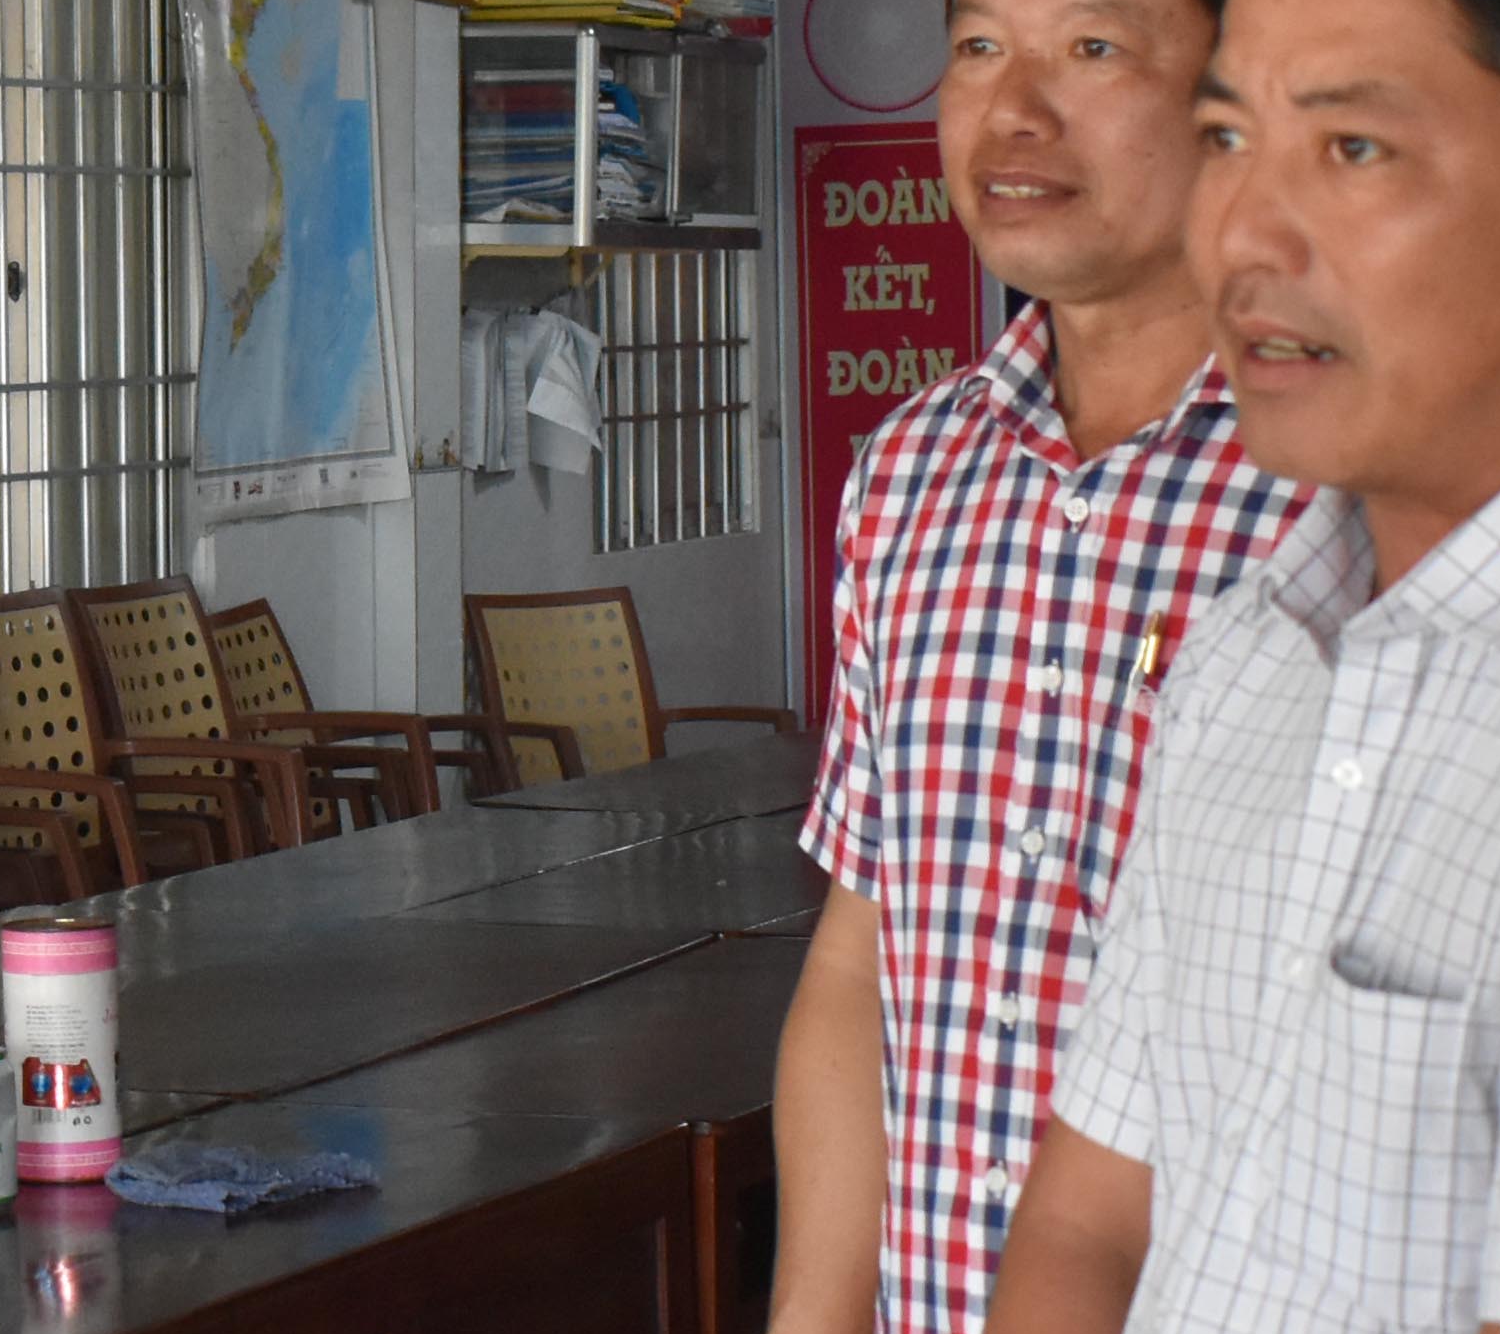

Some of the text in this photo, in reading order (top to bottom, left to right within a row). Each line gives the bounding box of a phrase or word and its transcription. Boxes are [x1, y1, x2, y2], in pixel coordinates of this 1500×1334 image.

[823, 164, 952, 228] ĐOÀN
[843, 244, 936, 315] KẾT,
[827, 335, 954, 396] ĐOÀN
